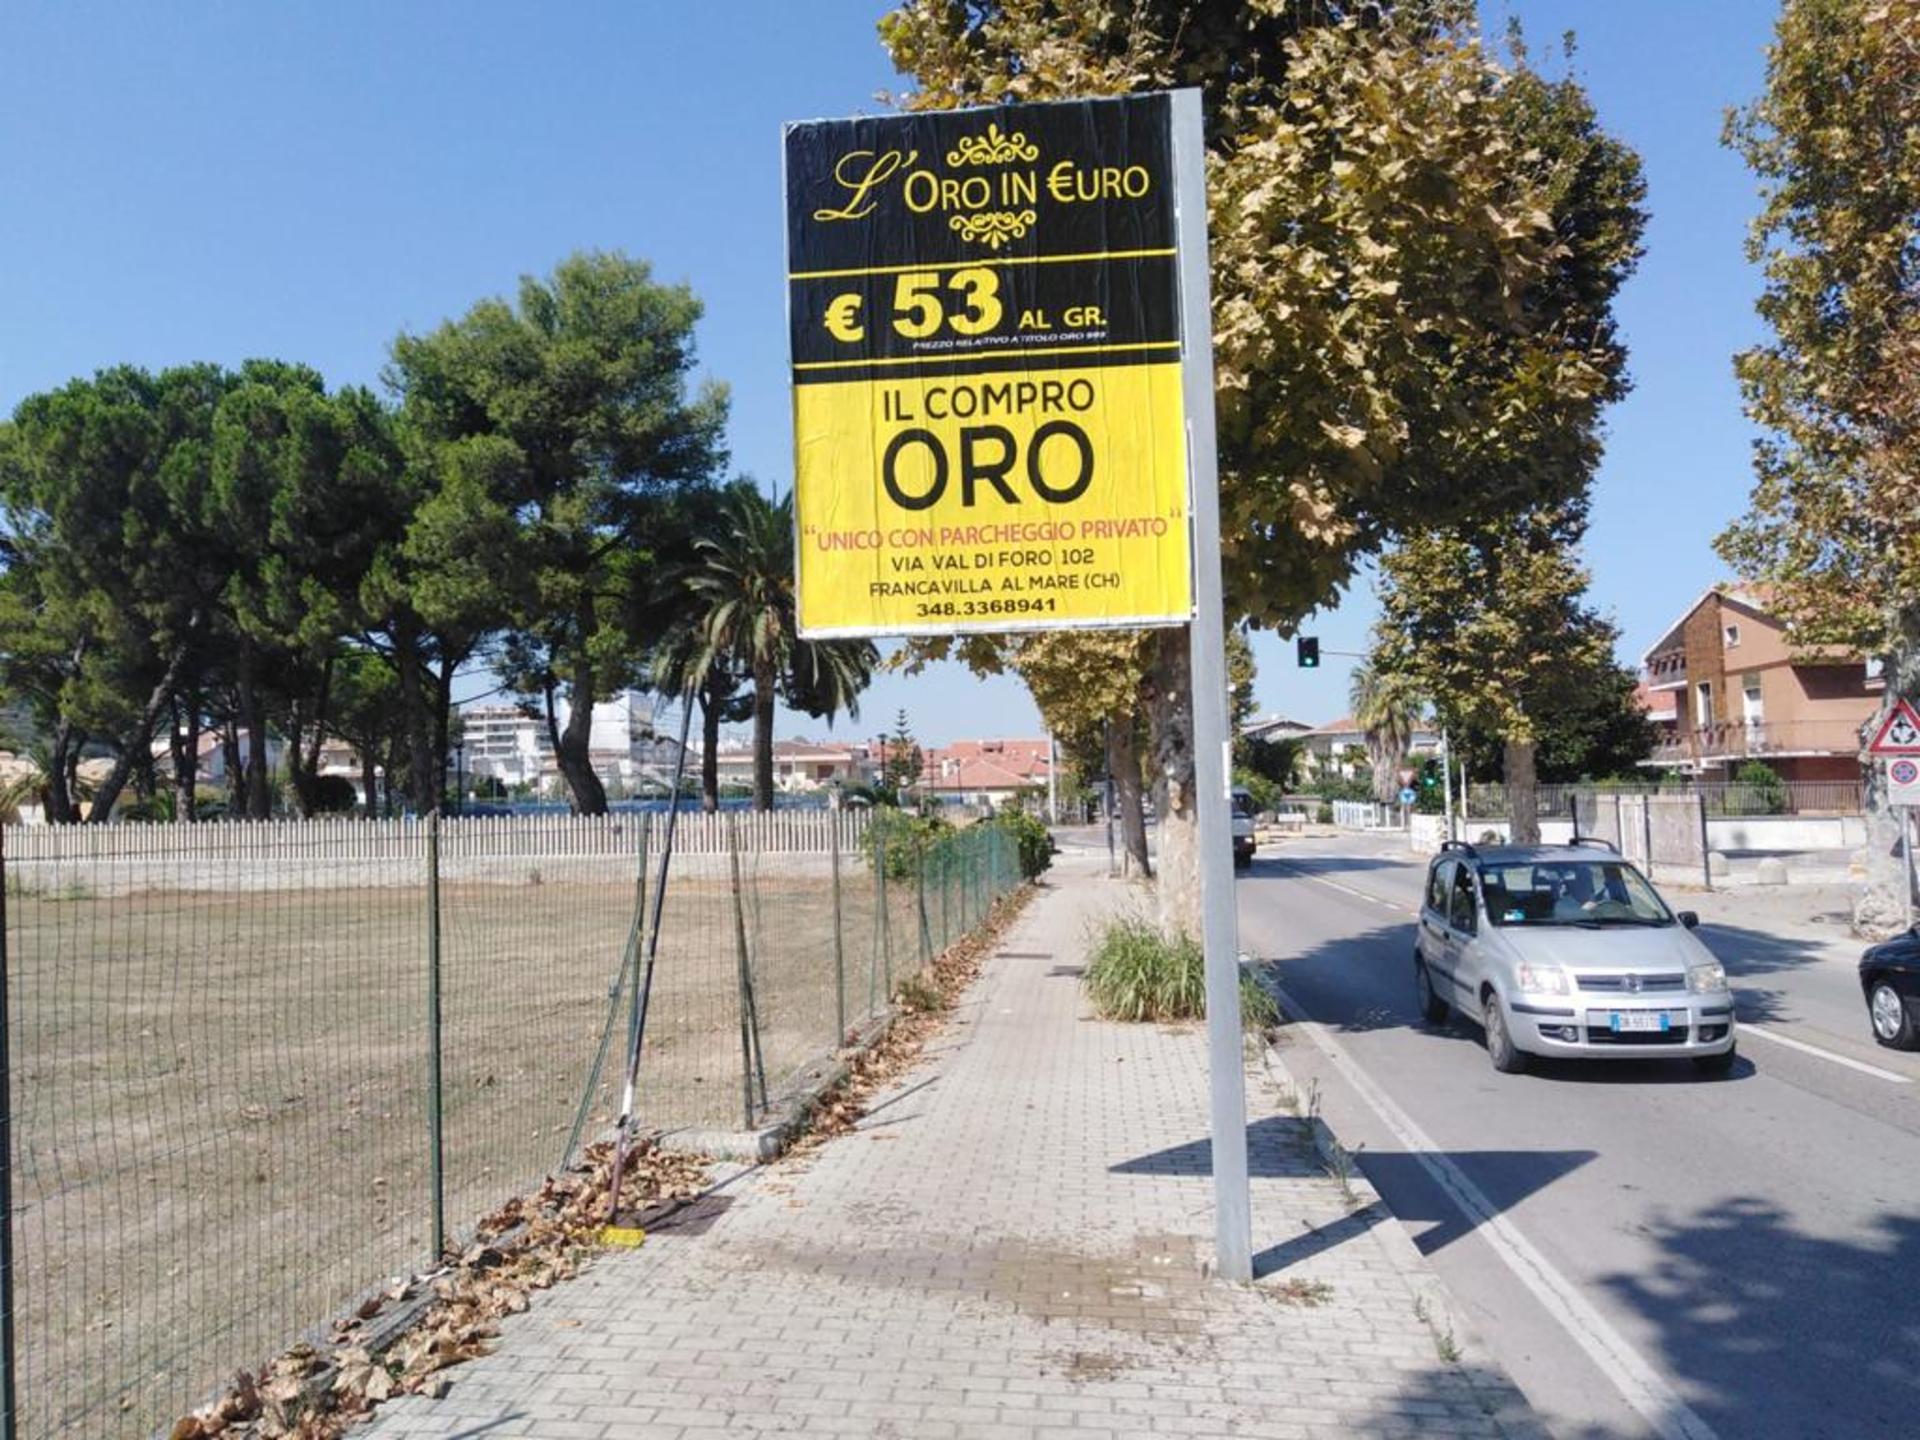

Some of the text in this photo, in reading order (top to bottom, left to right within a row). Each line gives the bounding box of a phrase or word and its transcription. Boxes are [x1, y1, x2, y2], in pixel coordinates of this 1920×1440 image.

[1001, 169, 1038, 205] IN
[824, 266, 1108, 342] € 53 AL GR.
[912, 340, 953, 350] PREZZO
[956, 336, 1010, 347] RELATIVO
[1021, 334, 1057, 344] TITOLO
[1059, 332, 1085, 340] ORO
[883, 378, 1095, 422] IL COMPRO
[882, 419, 1095, 511] ORO
[888, 528, 935, 548] CON
[940, 521, 1076, 546] PARCHEGGIO
[891, 548, 1095, 572] VIA VAL DI FORO 102
[869, 572, 1121, 597] FRANCAVILLA AL MARE (CH)
[916, 597, 1057, 617] 348.3368941
